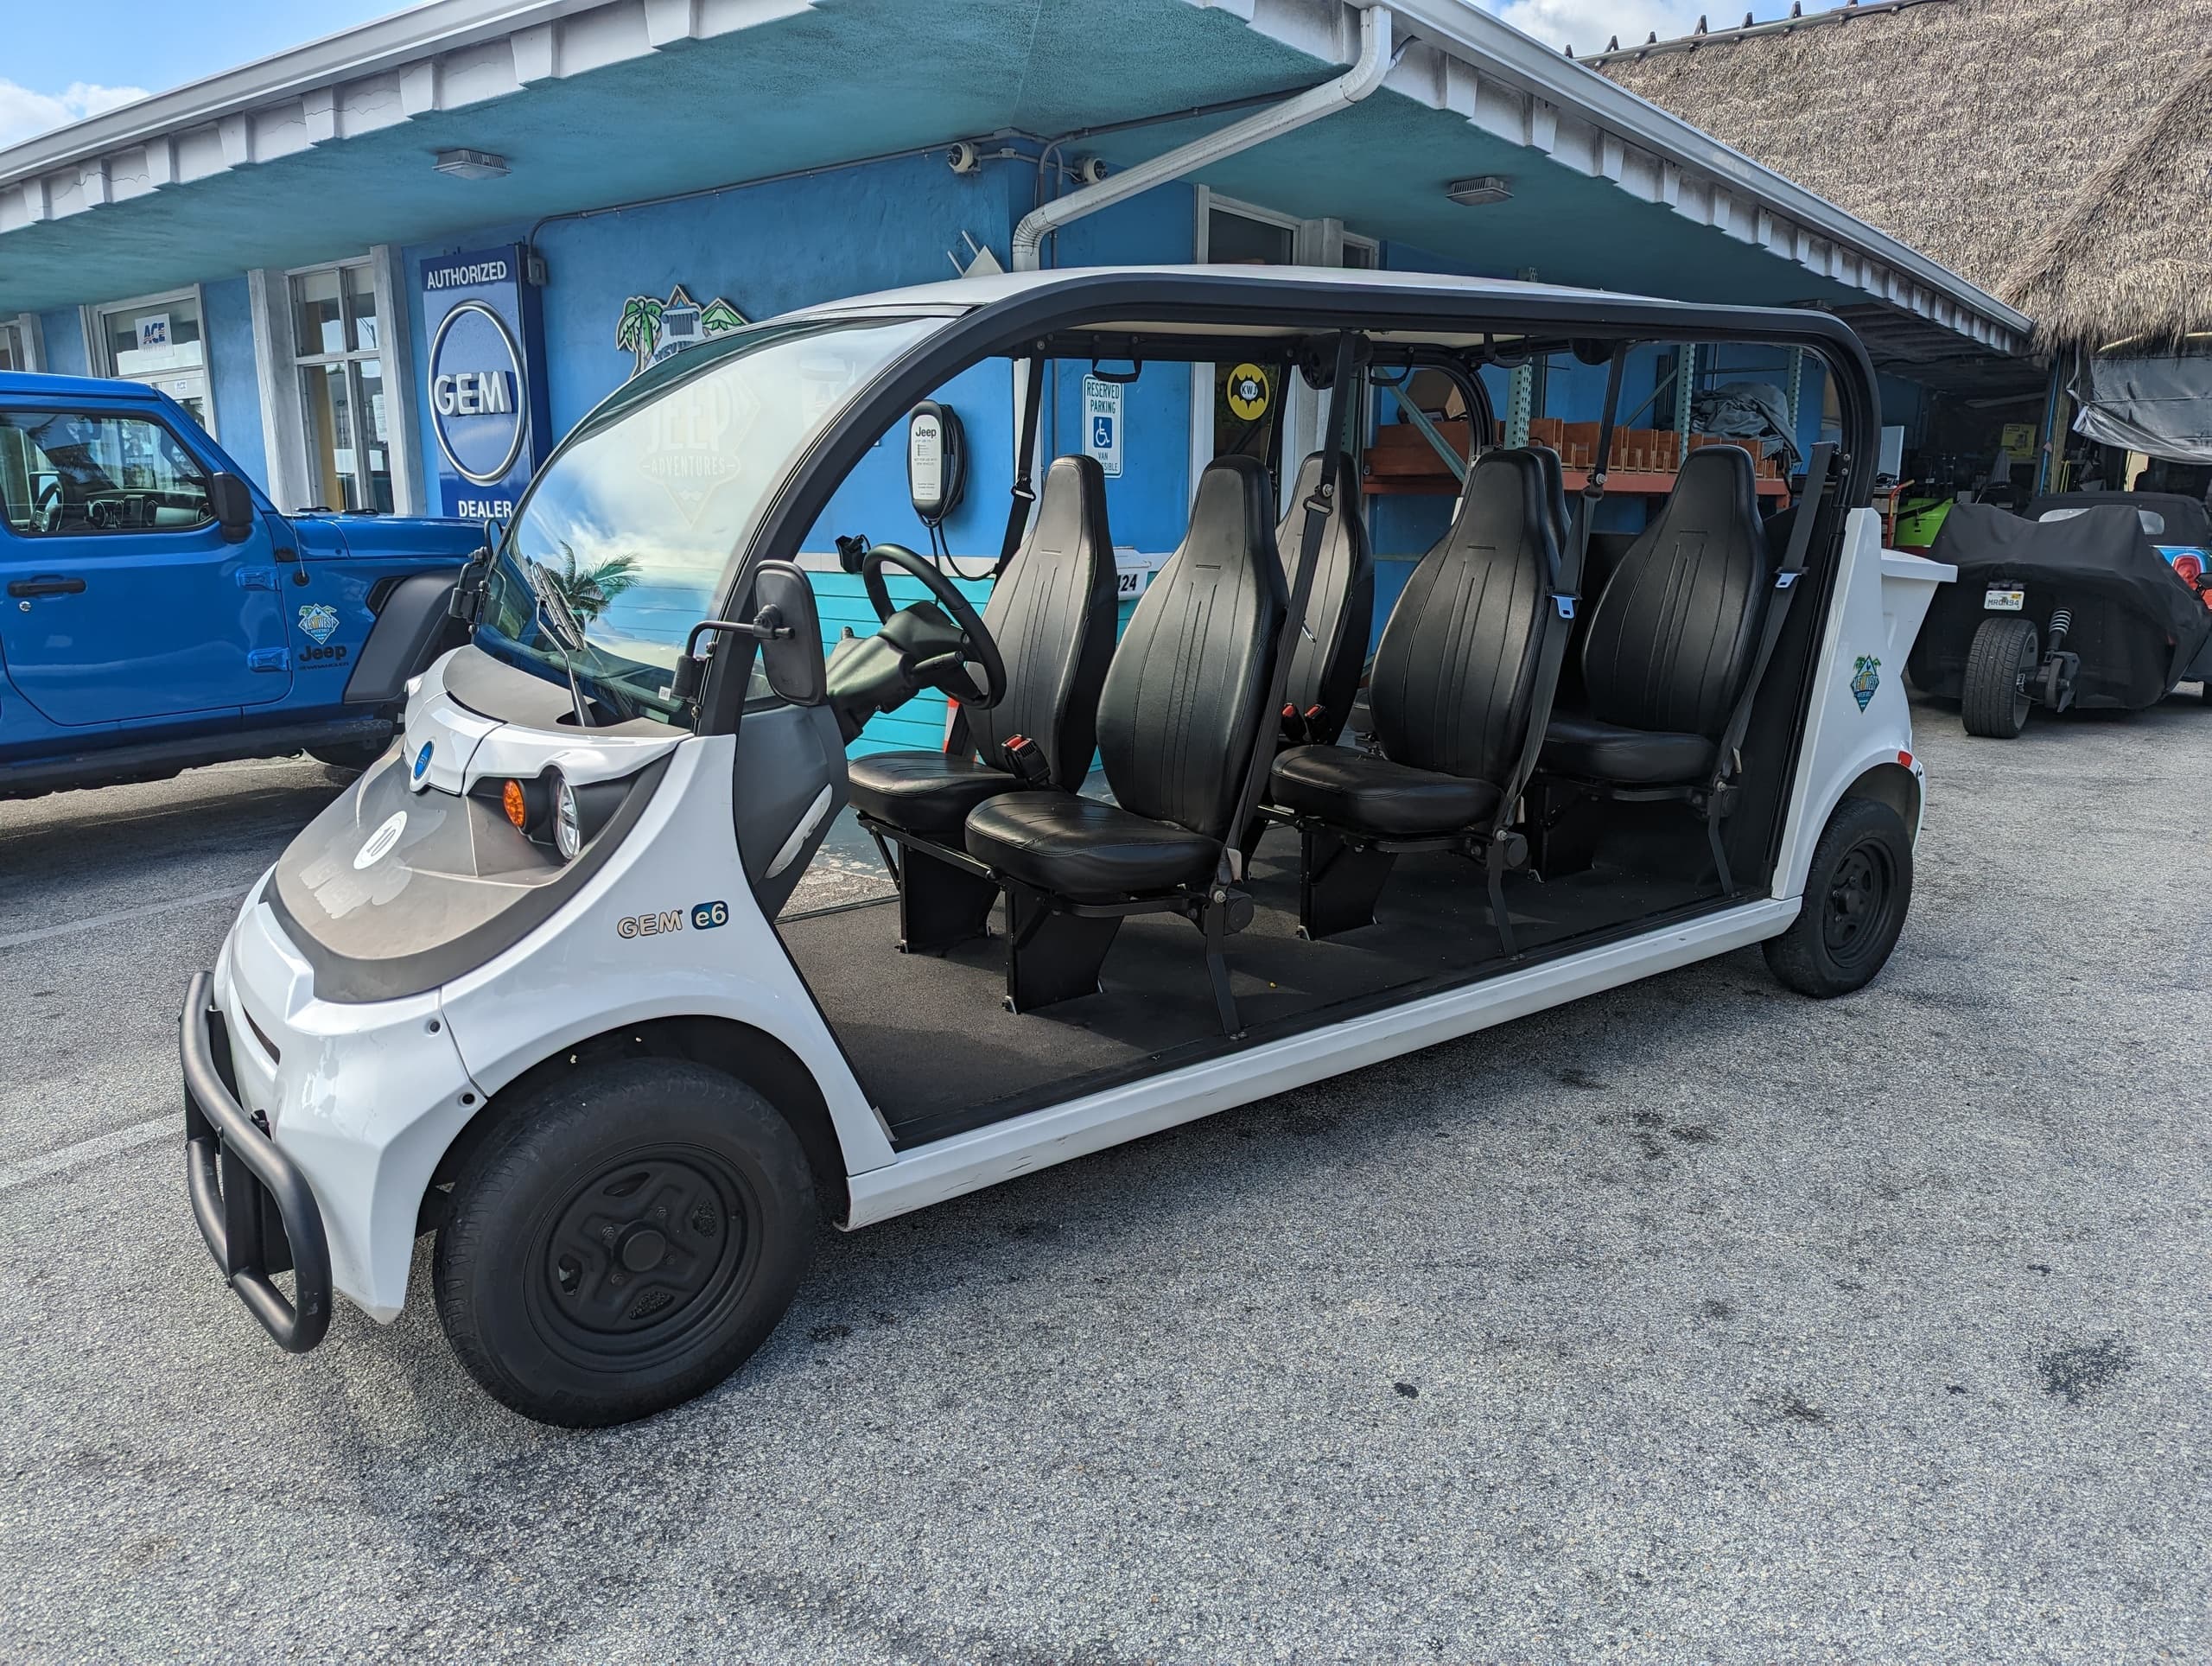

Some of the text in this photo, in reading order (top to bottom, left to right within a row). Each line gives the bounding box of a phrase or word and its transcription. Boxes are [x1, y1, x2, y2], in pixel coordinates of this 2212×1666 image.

[427, 261, 507, 290] AUTHORIZED
[143, 321, 166, 345] ACE
[434, 371, 508, 416] GEM
[1086, 381, 1120, 399] RESERVED
[1242, 385, 1258, 396] KWJ
[1090, 399, 1116, 415] PARKING
[915, 426, 937, 439] Jeep
[1098, 451, 1109, 461] VAN
[651, 455, 727, 478] ADVENTURES
[458, 500, 512, 518] DEALER
[299, 645, 347, 663] Jeep
[617, 903, 727, 939] GEM e6
